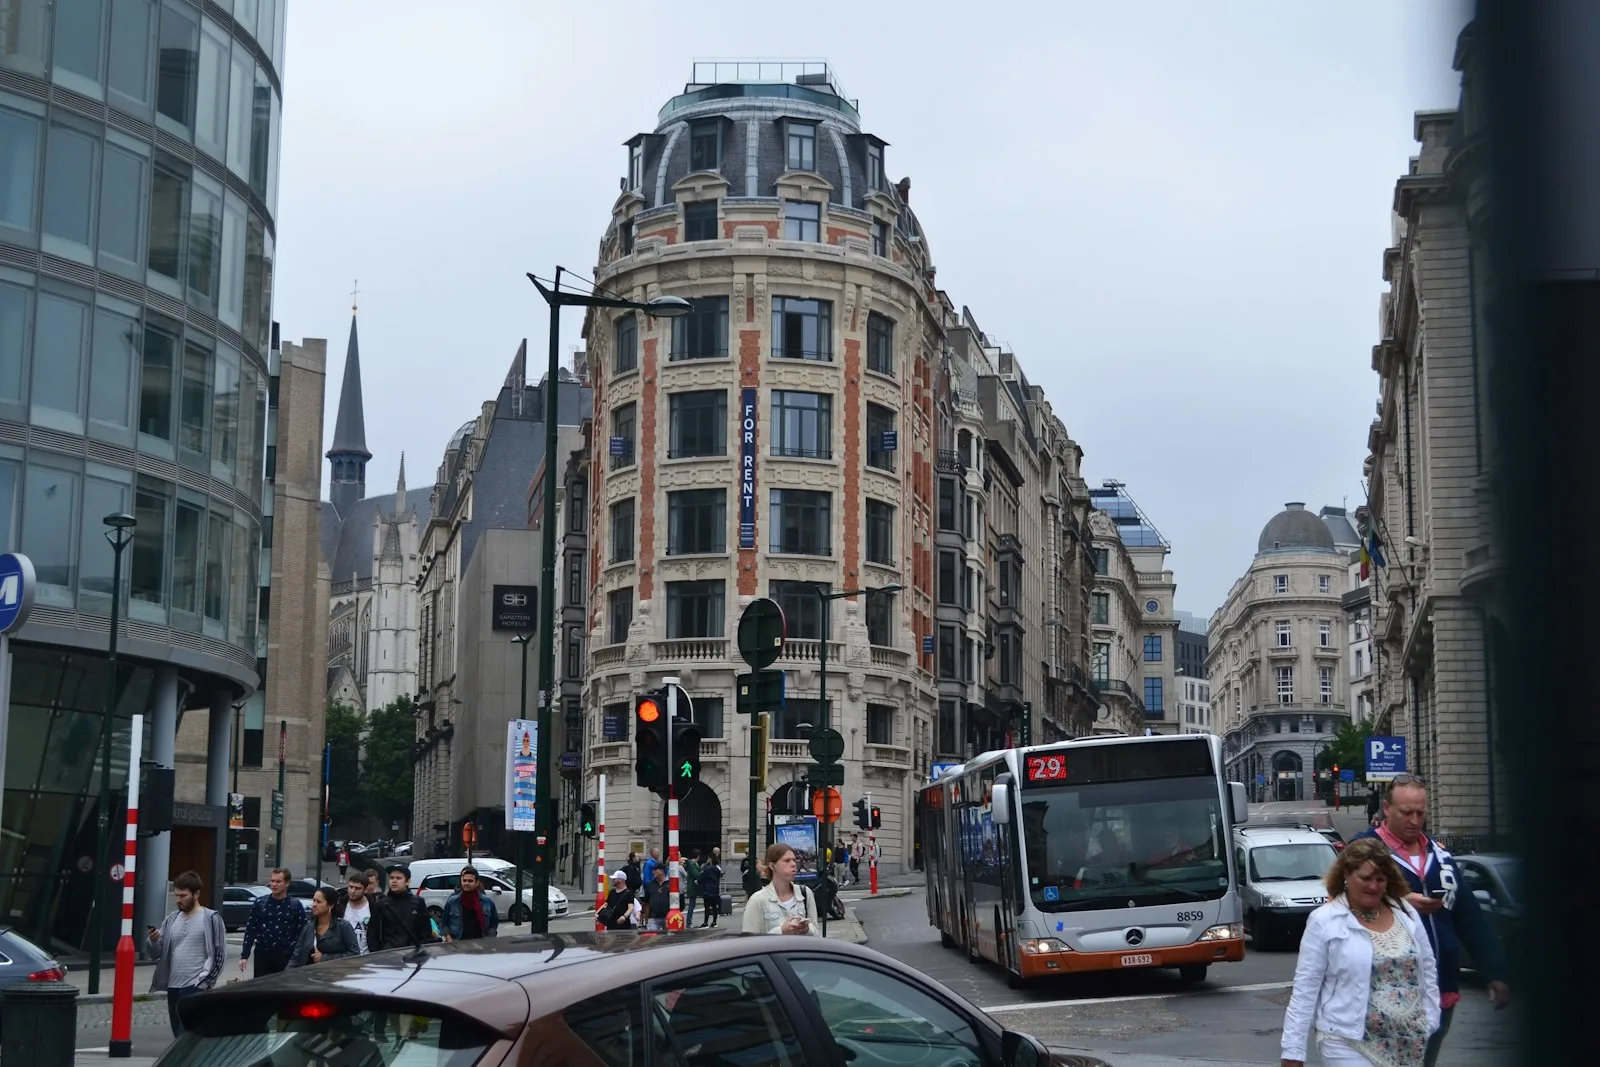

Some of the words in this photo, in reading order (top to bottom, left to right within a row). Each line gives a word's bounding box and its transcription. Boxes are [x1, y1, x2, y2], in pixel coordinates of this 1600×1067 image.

[744, 405, 754, 444] FOR
[743, 455, 753, 508] RENT
[503, 594, 527, 606] SH
[1371, 741, 1384, 759] P
[1033, 758, 1061, 779] 29
[1177, 910, 1204, 922] 8859
